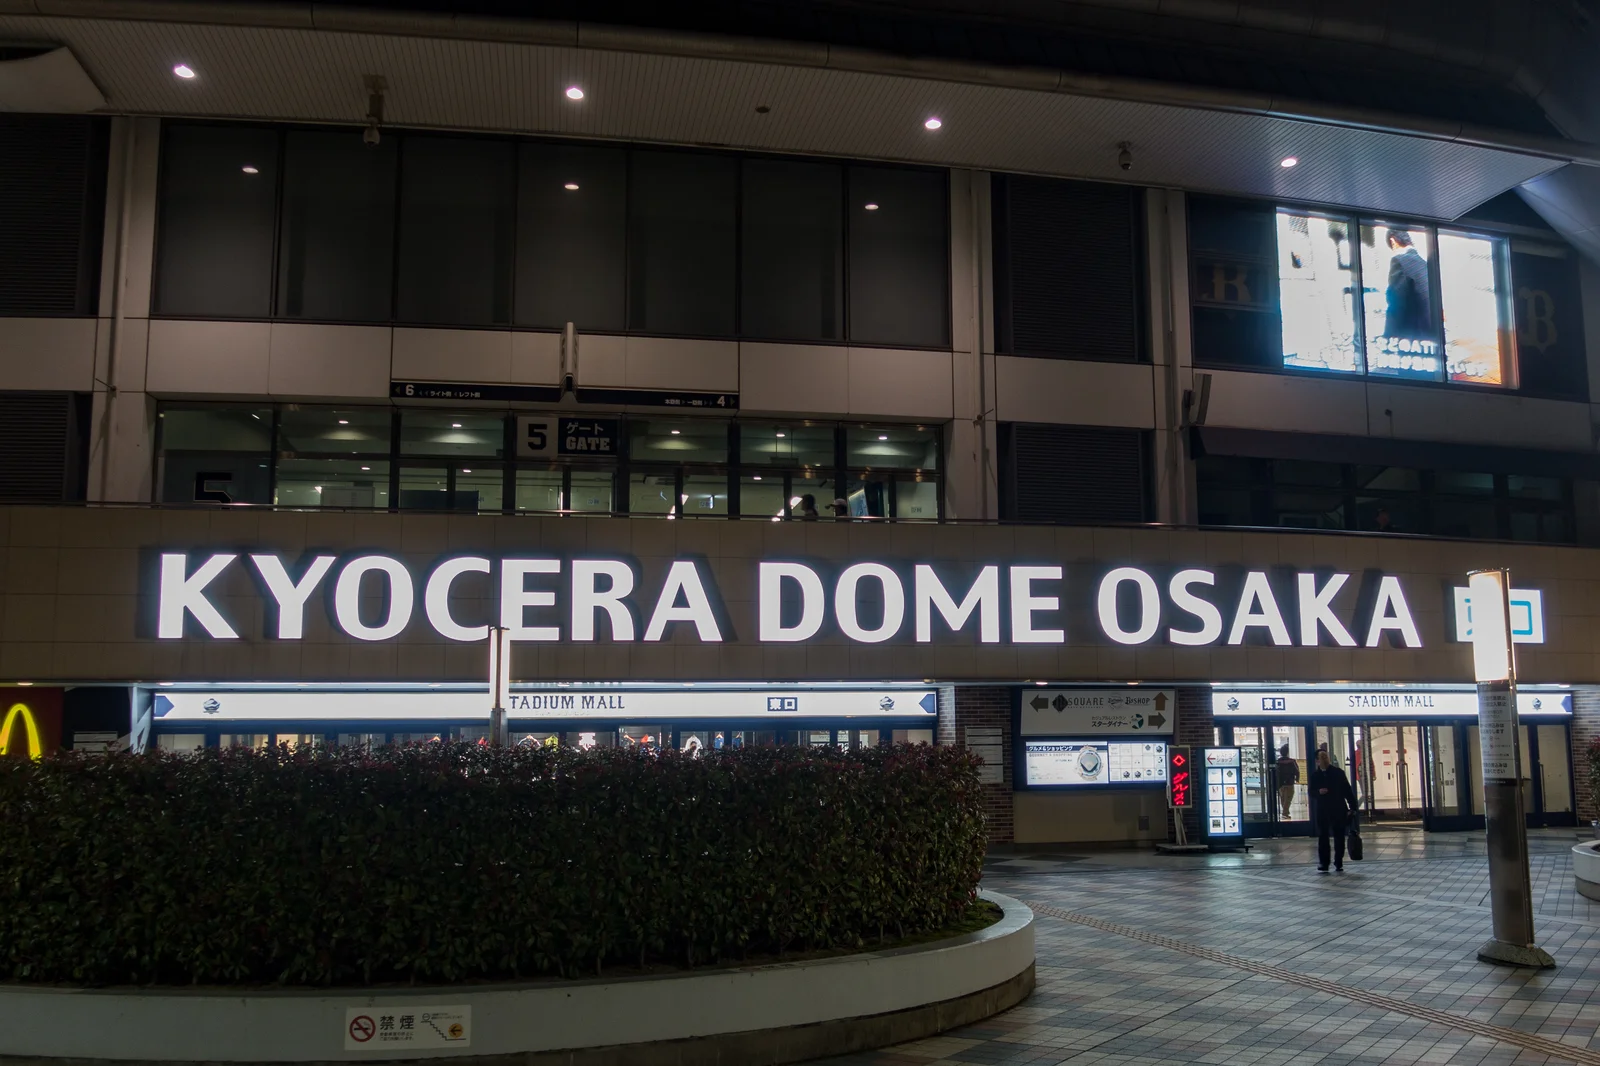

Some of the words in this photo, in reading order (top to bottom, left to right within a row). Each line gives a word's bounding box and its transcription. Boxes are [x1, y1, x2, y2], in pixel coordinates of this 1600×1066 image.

[405, 384, 415, 396] 6
[717, 395, 726, 407] 4
[566, 422, 604, 435] ゲート
[527, 423, 548, 450] 5
[565, 436, 610, 451] GATE
[157, 552, 723, 643] KYOCERA
[758, 562, 1065, 644] DOME
[1096, 566, 1423, 649] OSAKA
[1463, 597, 1533, 636] 口
[508, 695, 575, 710] TADIUM
[581, 695, 625, 710] MALL
[769, 697, 797, 711] 東口
[1067, 697, 1104, 706] SQUARE
[1348, 695, 1400, 708] STADIUM
[1404, 695, 1434, 708] MALL
[1091, 720, 1128, 728] スターダイナー
[1173, 772, 1189, 806] グルメ
[380, 1014, 415, 1031] 禁煙
